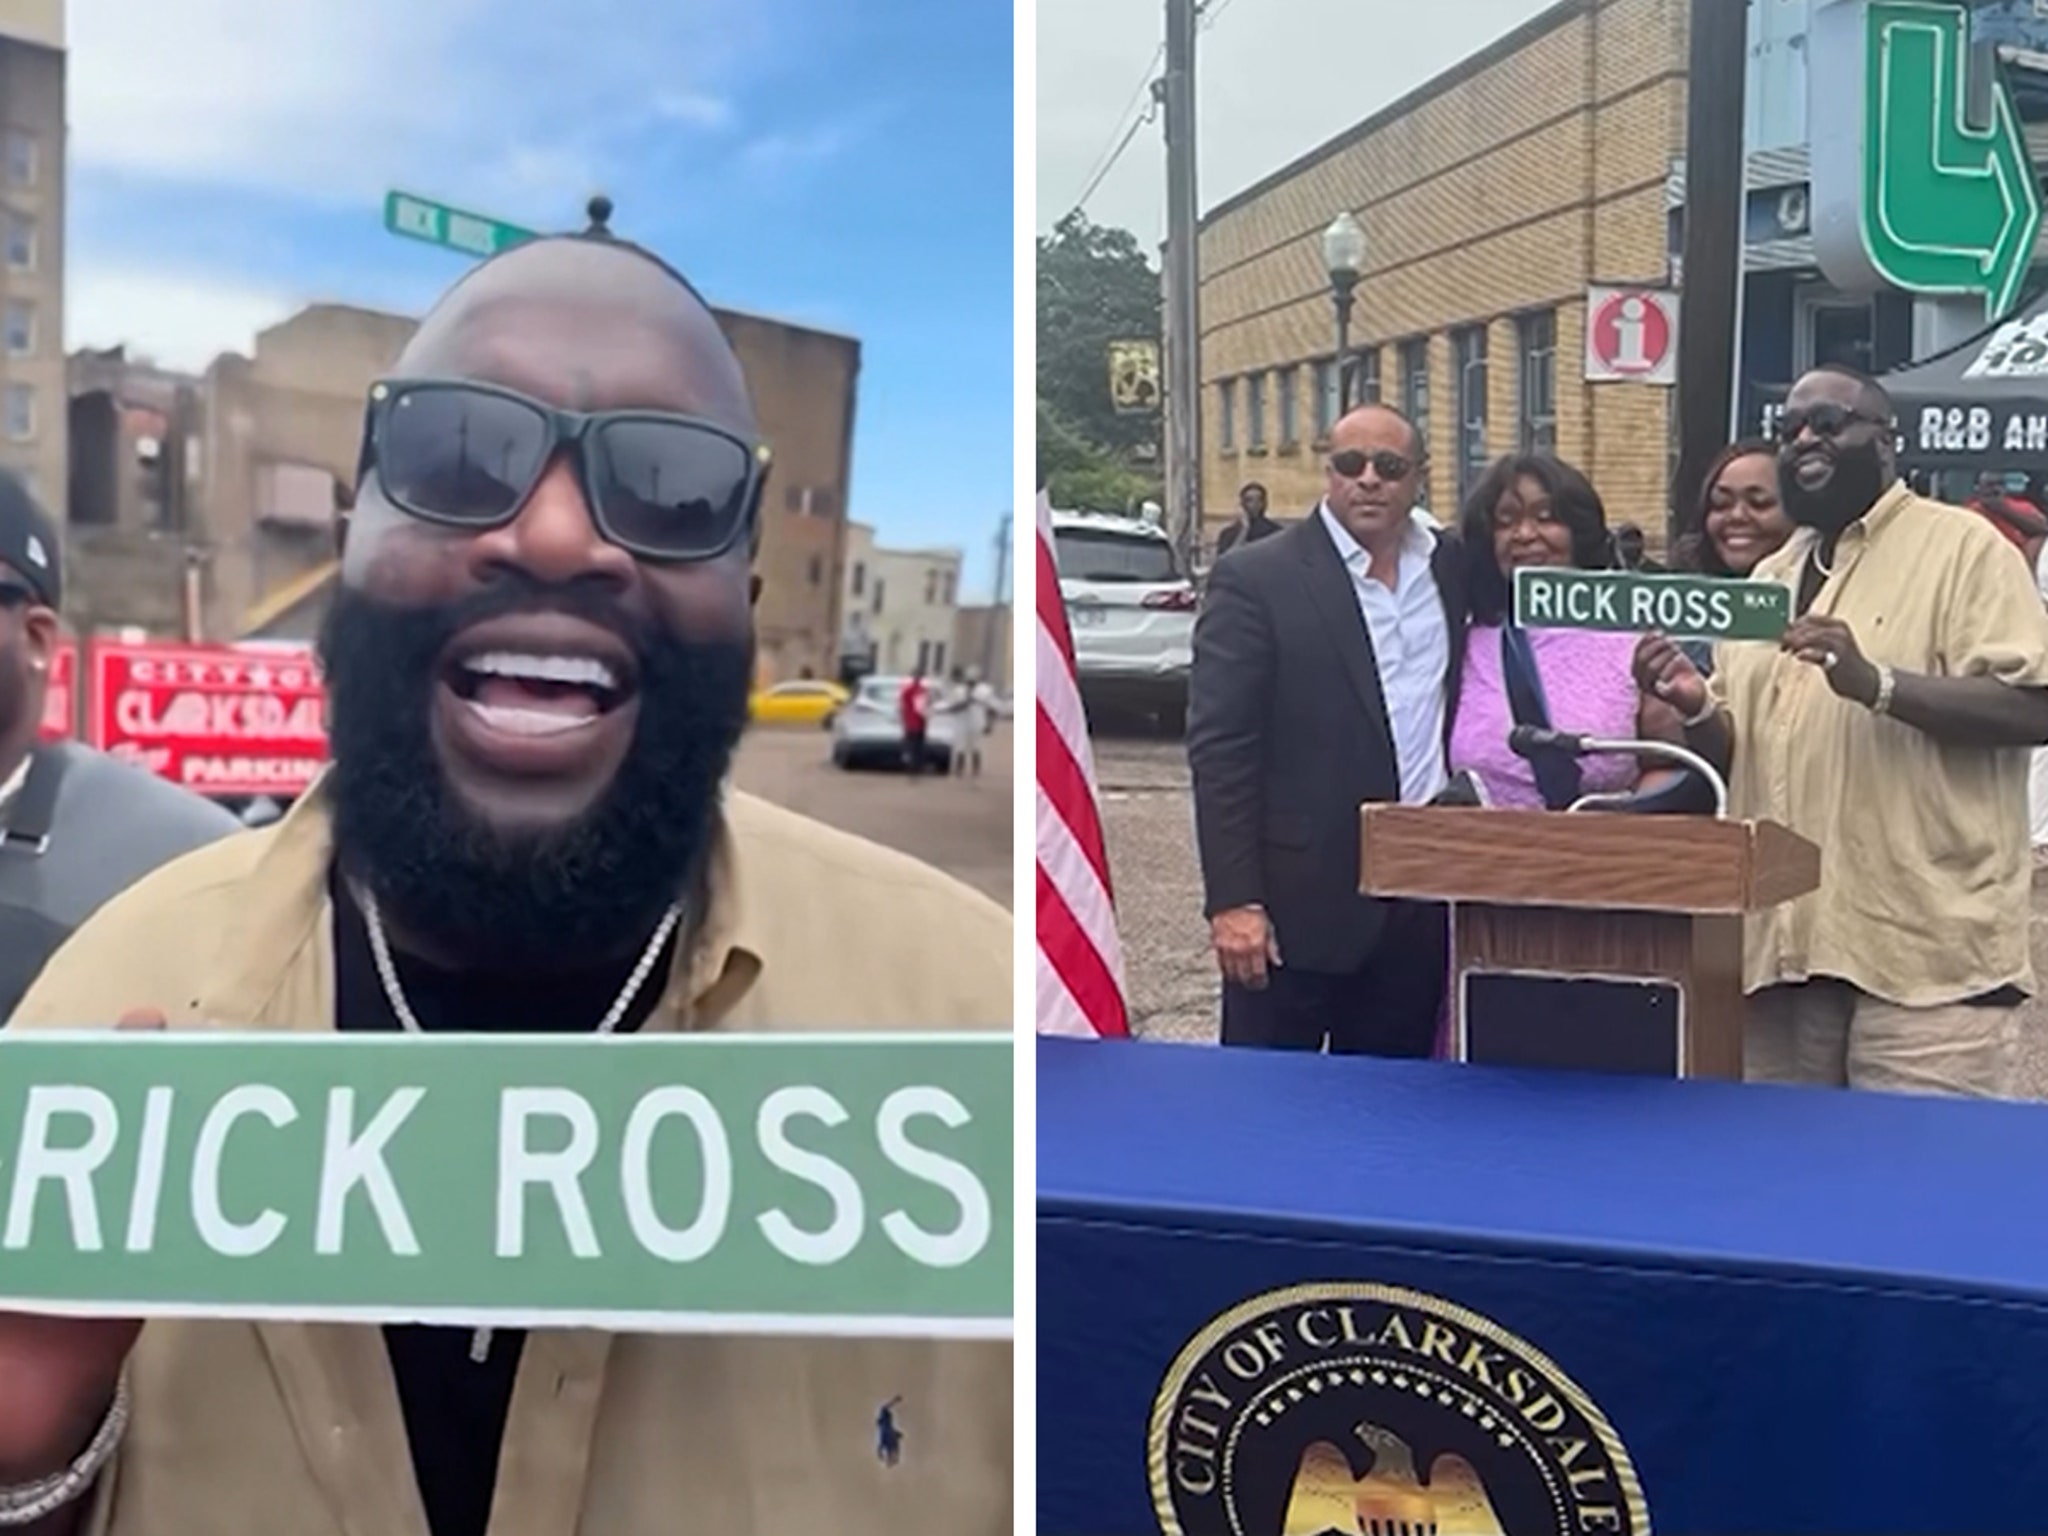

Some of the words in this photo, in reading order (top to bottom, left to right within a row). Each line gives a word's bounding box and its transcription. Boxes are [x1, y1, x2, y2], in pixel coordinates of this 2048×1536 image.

[1920, 406, 1991, 450] R&B
[1529, 579, 1618, 622] RICK
[1631, 586, 1732, 629] ROSS
[3, 1084, 428, 1257] RICK
[496, 1083, 991, 1268] ROSS
[1173, 1374, 1233, 1496] CITY
[1223, 1321, 1289, 1381] OF
[1298, 1306, 1622, 1535] CLARKSDALE
